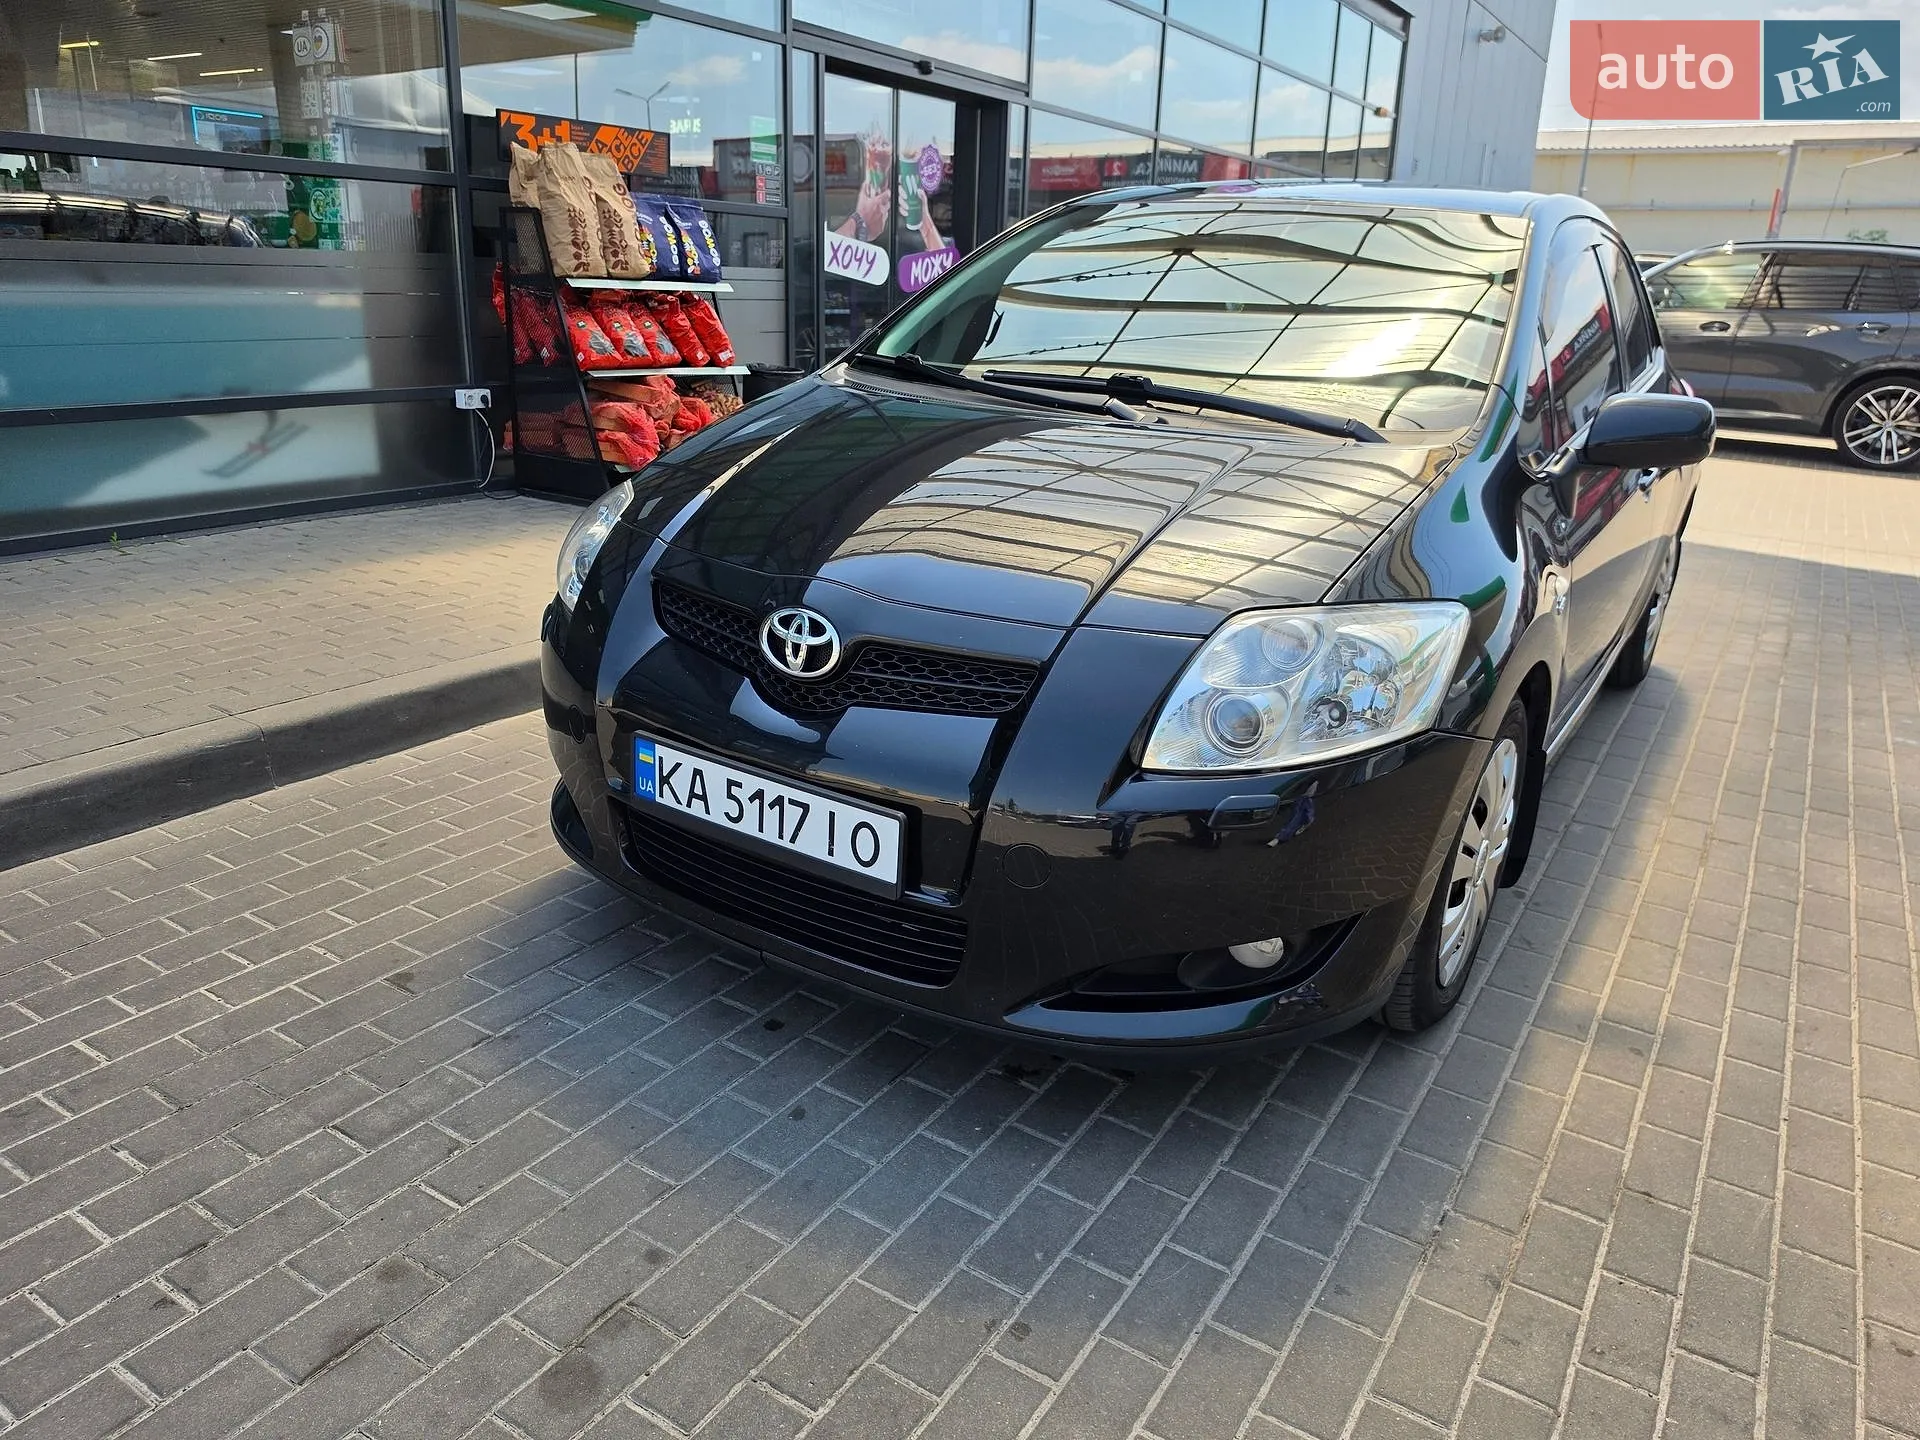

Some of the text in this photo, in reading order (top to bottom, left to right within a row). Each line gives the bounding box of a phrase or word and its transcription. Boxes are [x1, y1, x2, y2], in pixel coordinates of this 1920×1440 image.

[296, 39, 308, 54] UA
[827, 240, 877, 279] ХОЧУ
[911, 252, 954, 287] МОЖУ
[639, 776, 654, 794] UA
[658, 755, 880, 868] KA 5117 IO
